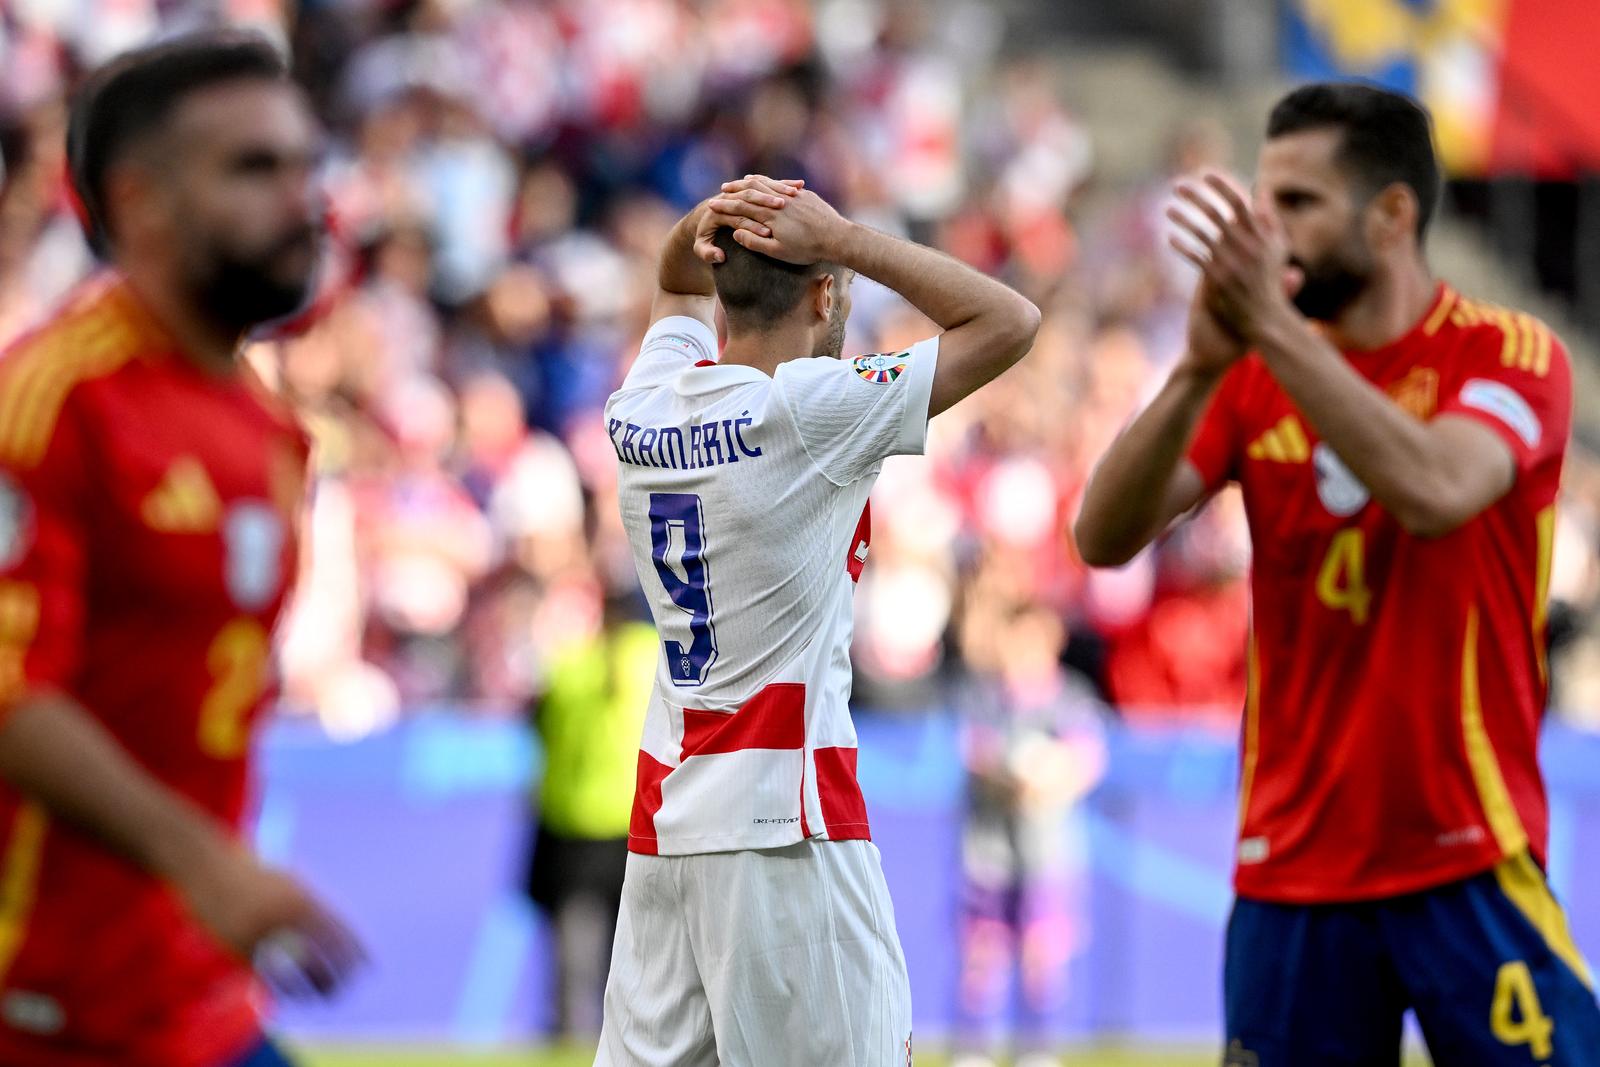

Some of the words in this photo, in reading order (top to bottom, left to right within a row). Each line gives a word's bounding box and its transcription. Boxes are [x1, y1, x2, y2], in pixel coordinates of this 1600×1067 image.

[609, 410, 762, 470] KRAMARIĆ
[649, 493, 718, 686] 9
[1316, 527, 1371, 625] 4
[1490, 961, 1553, 1060] 4
